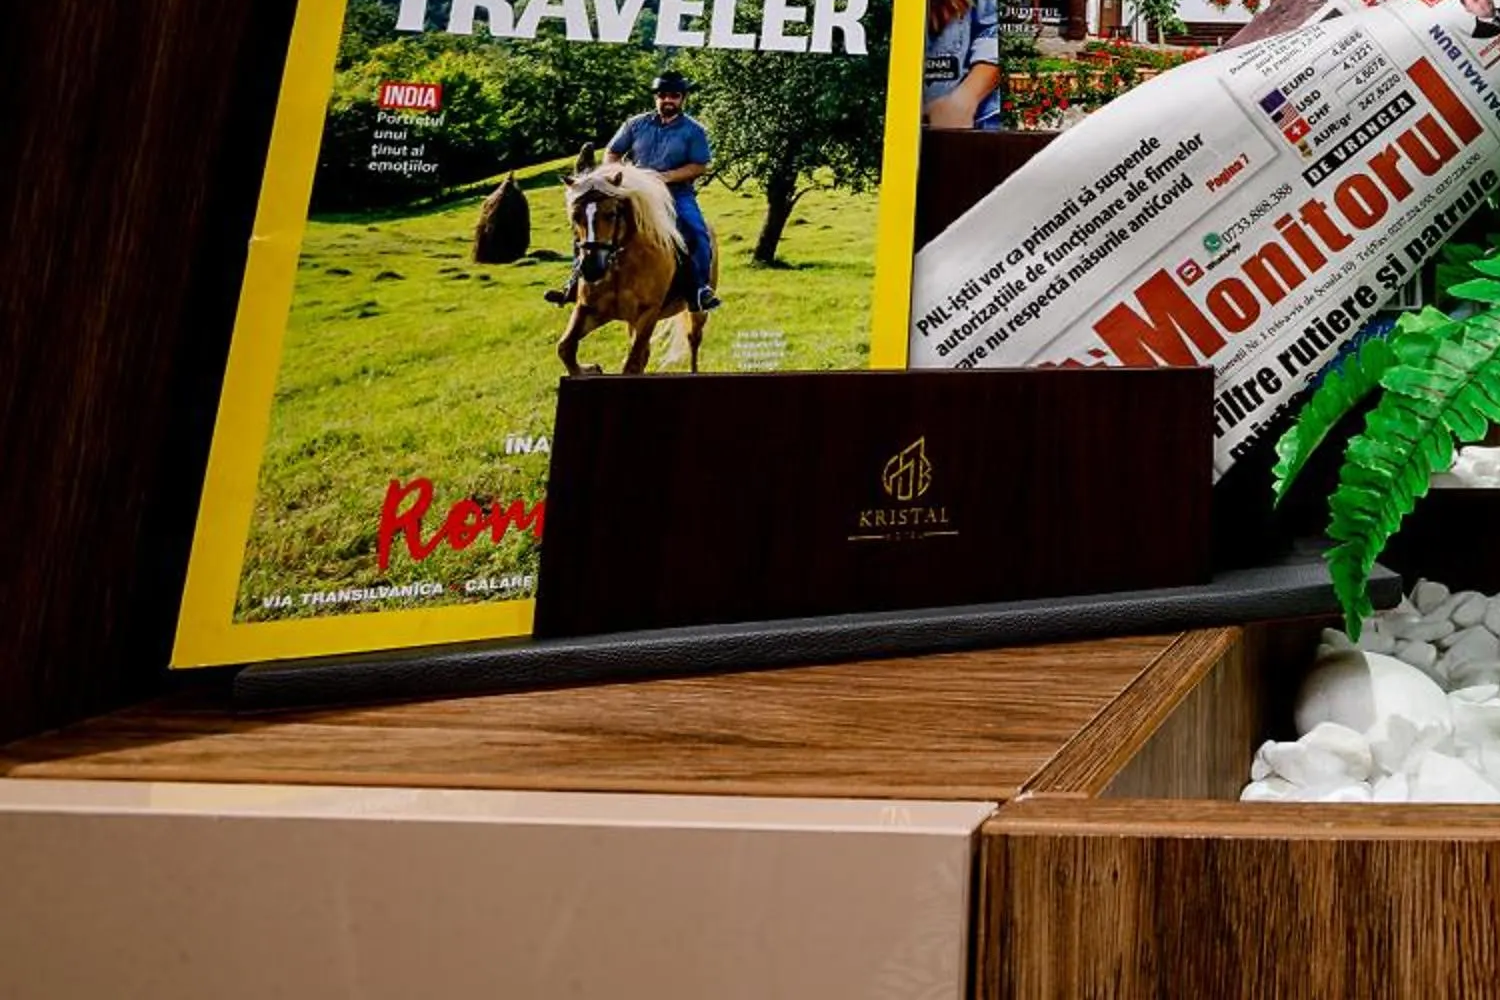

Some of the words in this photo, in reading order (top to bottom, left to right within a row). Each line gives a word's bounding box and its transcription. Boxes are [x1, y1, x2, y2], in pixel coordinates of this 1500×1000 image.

[1428, 24, 1462, 61] BUN
[1281, 66, 1316, 97] EURO
[1295, 89, 1321, 113] USD
[1342, 43, 1374, 71] 4,1221
[1457, 60, 1489, 94] MAI
[383, 85, 437, 107] INDIA
[377, 112, 445, 127] Portretul
[1307, 102, 1332, 126] CHF
[371, 144, 407, 157] ținut
[410, 144, 425, 156] al
[373, 129, 407, 140] unui
[1307, 159, 1332, 183] DE
[1332, 96, 1412, 161] VRANCEA
[368, 160, 439, 174] emoțiilor
[1206, 158, 1245, 192] Pagina
[1240, 152, 1250, 165] 7
[979, 261, 1006, 286] vor
[1006, 249, 1025, 266] ca
[1022, 201, 1081, 258] primarii
[1080, 185, 1097, 207] să
[1095, 135, 1161, 194] suspende
[1092, 56, 1485, 367] Monitorul
[936, 277, 1028, 356] autorizațiile
[1026, 262, 1047, 285] de
[1043, 198, 1126, 266] funcționare
[1124, 177, 1148, 201] ale
[1145, 132, 1204, 184] firmelor
[955, 344, 985, 368] are
[987, 327, 1010, 349] nu
[1008, 275, 1071, 332] respectă
[1068, 227, 1131, 283] măsurile
[1129, 173, 1194, 233] antiCovid
[1277, 285, 1378, 379] rutiere
[1376, 253, 1408, 290] și
[1404, 168, 1499, 265] patrule
[859, 507, 949, 527] KRISTAL
[263, 595, 292, 609] VIA
[301, 582, 443, 605] TRANSILVANICA
